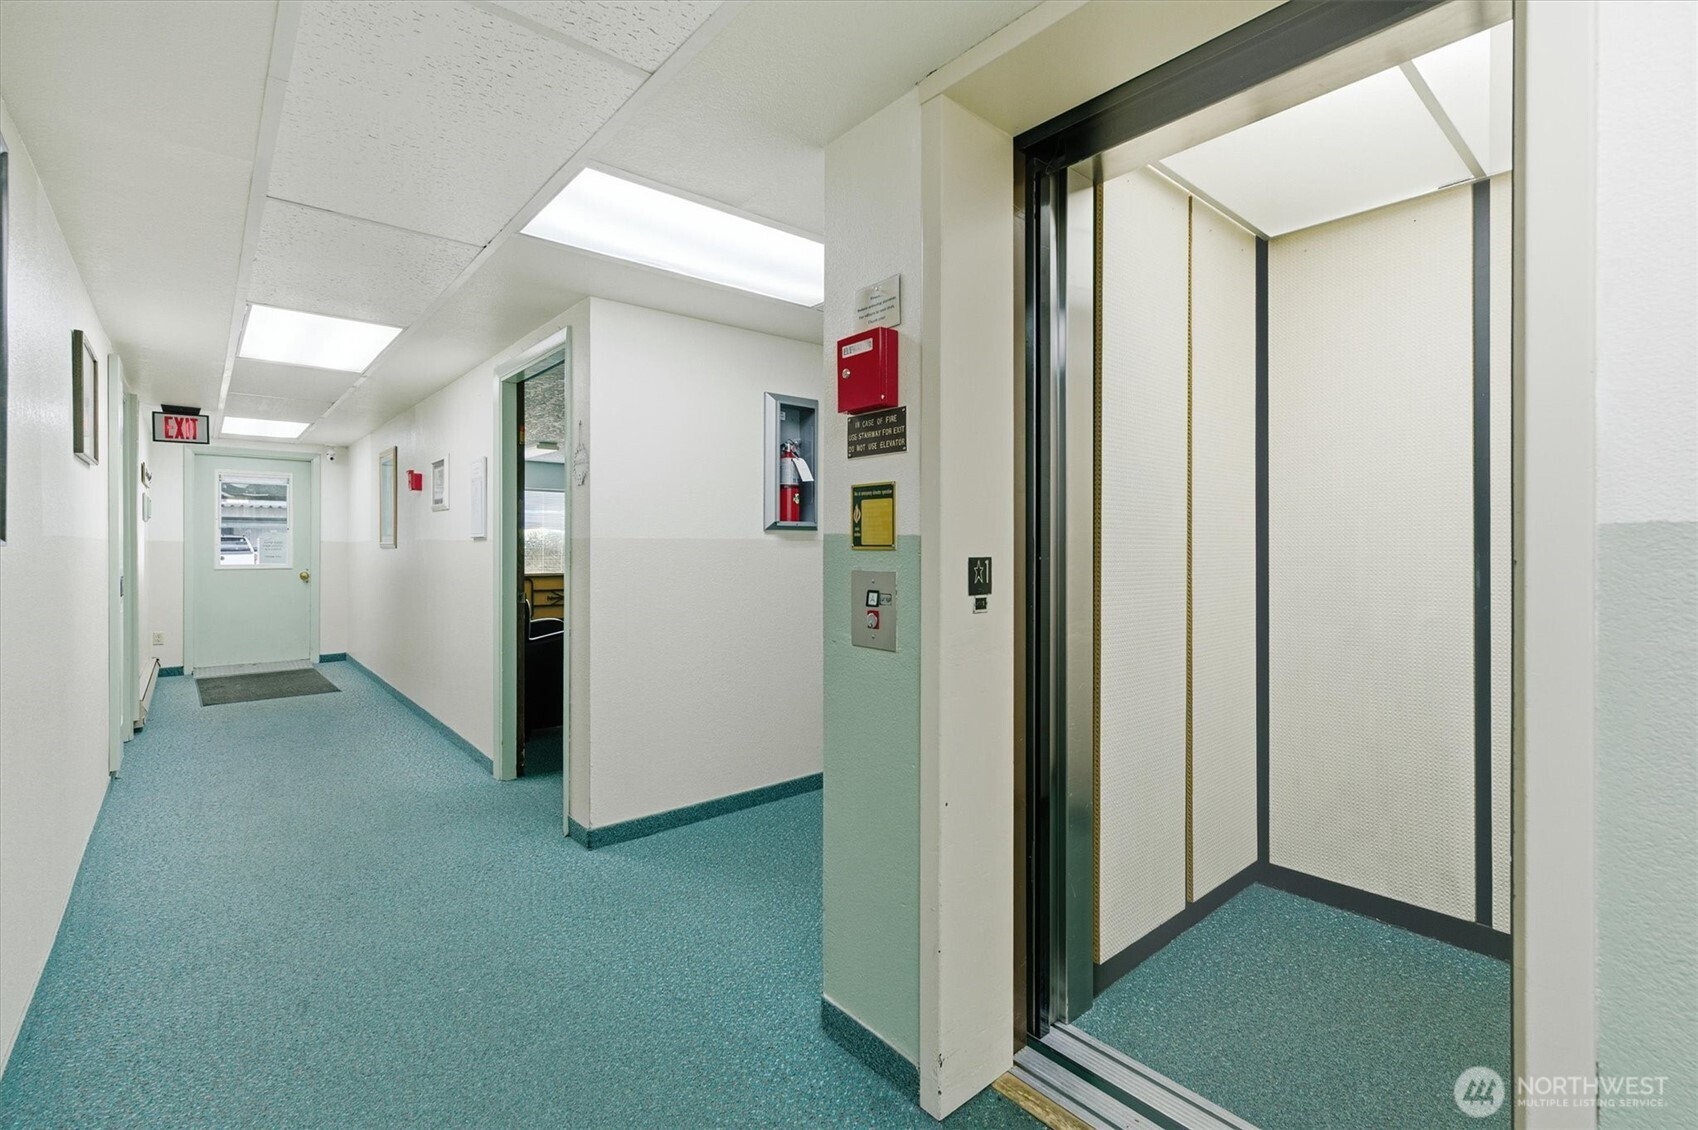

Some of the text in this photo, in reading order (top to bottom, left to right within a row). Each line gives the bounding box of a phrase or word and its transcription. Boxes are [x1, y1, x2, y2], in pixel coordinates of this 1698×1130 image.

[164, 416, 198, 440] EXIT
[862, 419, 874, 428] CASE
[876, 417, 883, 425] OF
[885, 414, 897, 423] FIRE
[858, 430, 881, 440] STAIRWAY
[882, 428, 892, 436] FOR
[893, 425, 905, 434] EXIT
[868, 442, 877, 450] USE
[880, 438, 905, 448] ELEVATOR
[985, 559, 989, 584] 1
